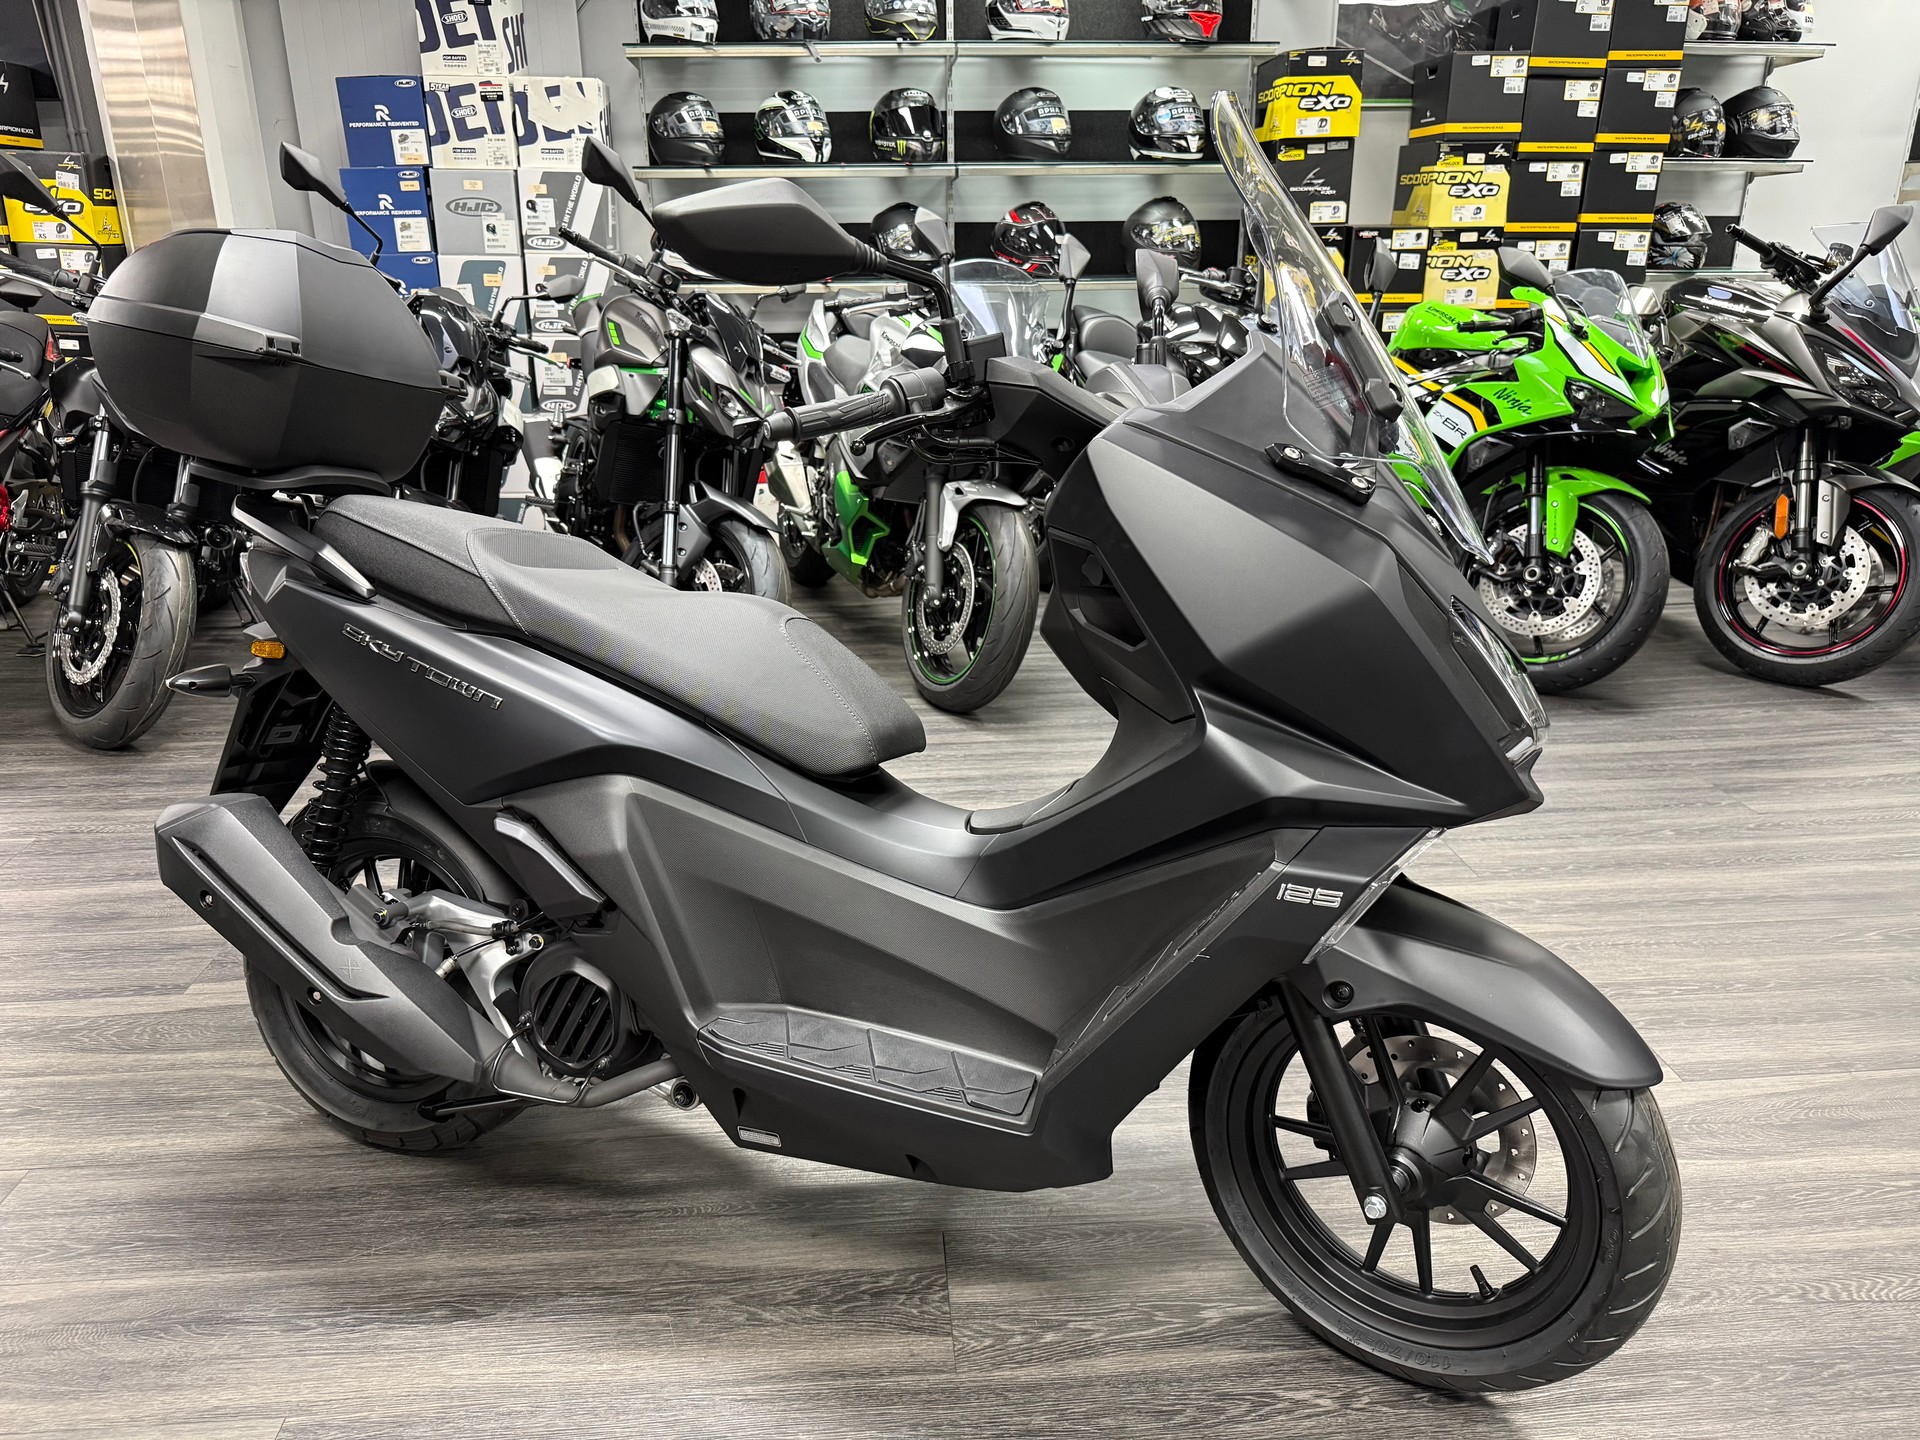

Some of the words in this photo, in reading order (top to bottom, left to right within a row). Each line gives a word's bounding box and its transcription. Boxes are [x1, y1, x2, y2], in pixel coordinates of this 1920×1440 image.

[1258, 83, 1333, 104] SCORPION
[569, 174, 582, 201] WORLD
[1400, 172, 1482, 185] SCORPION
[454, 202, 494, 212] HJC
[532, 238, 560, 246] HJC
[1493, 387, 1532, 415] Ninja
[1442, 417, 1468, 440] 6R
[1276, 883, 1344, 908] 125
